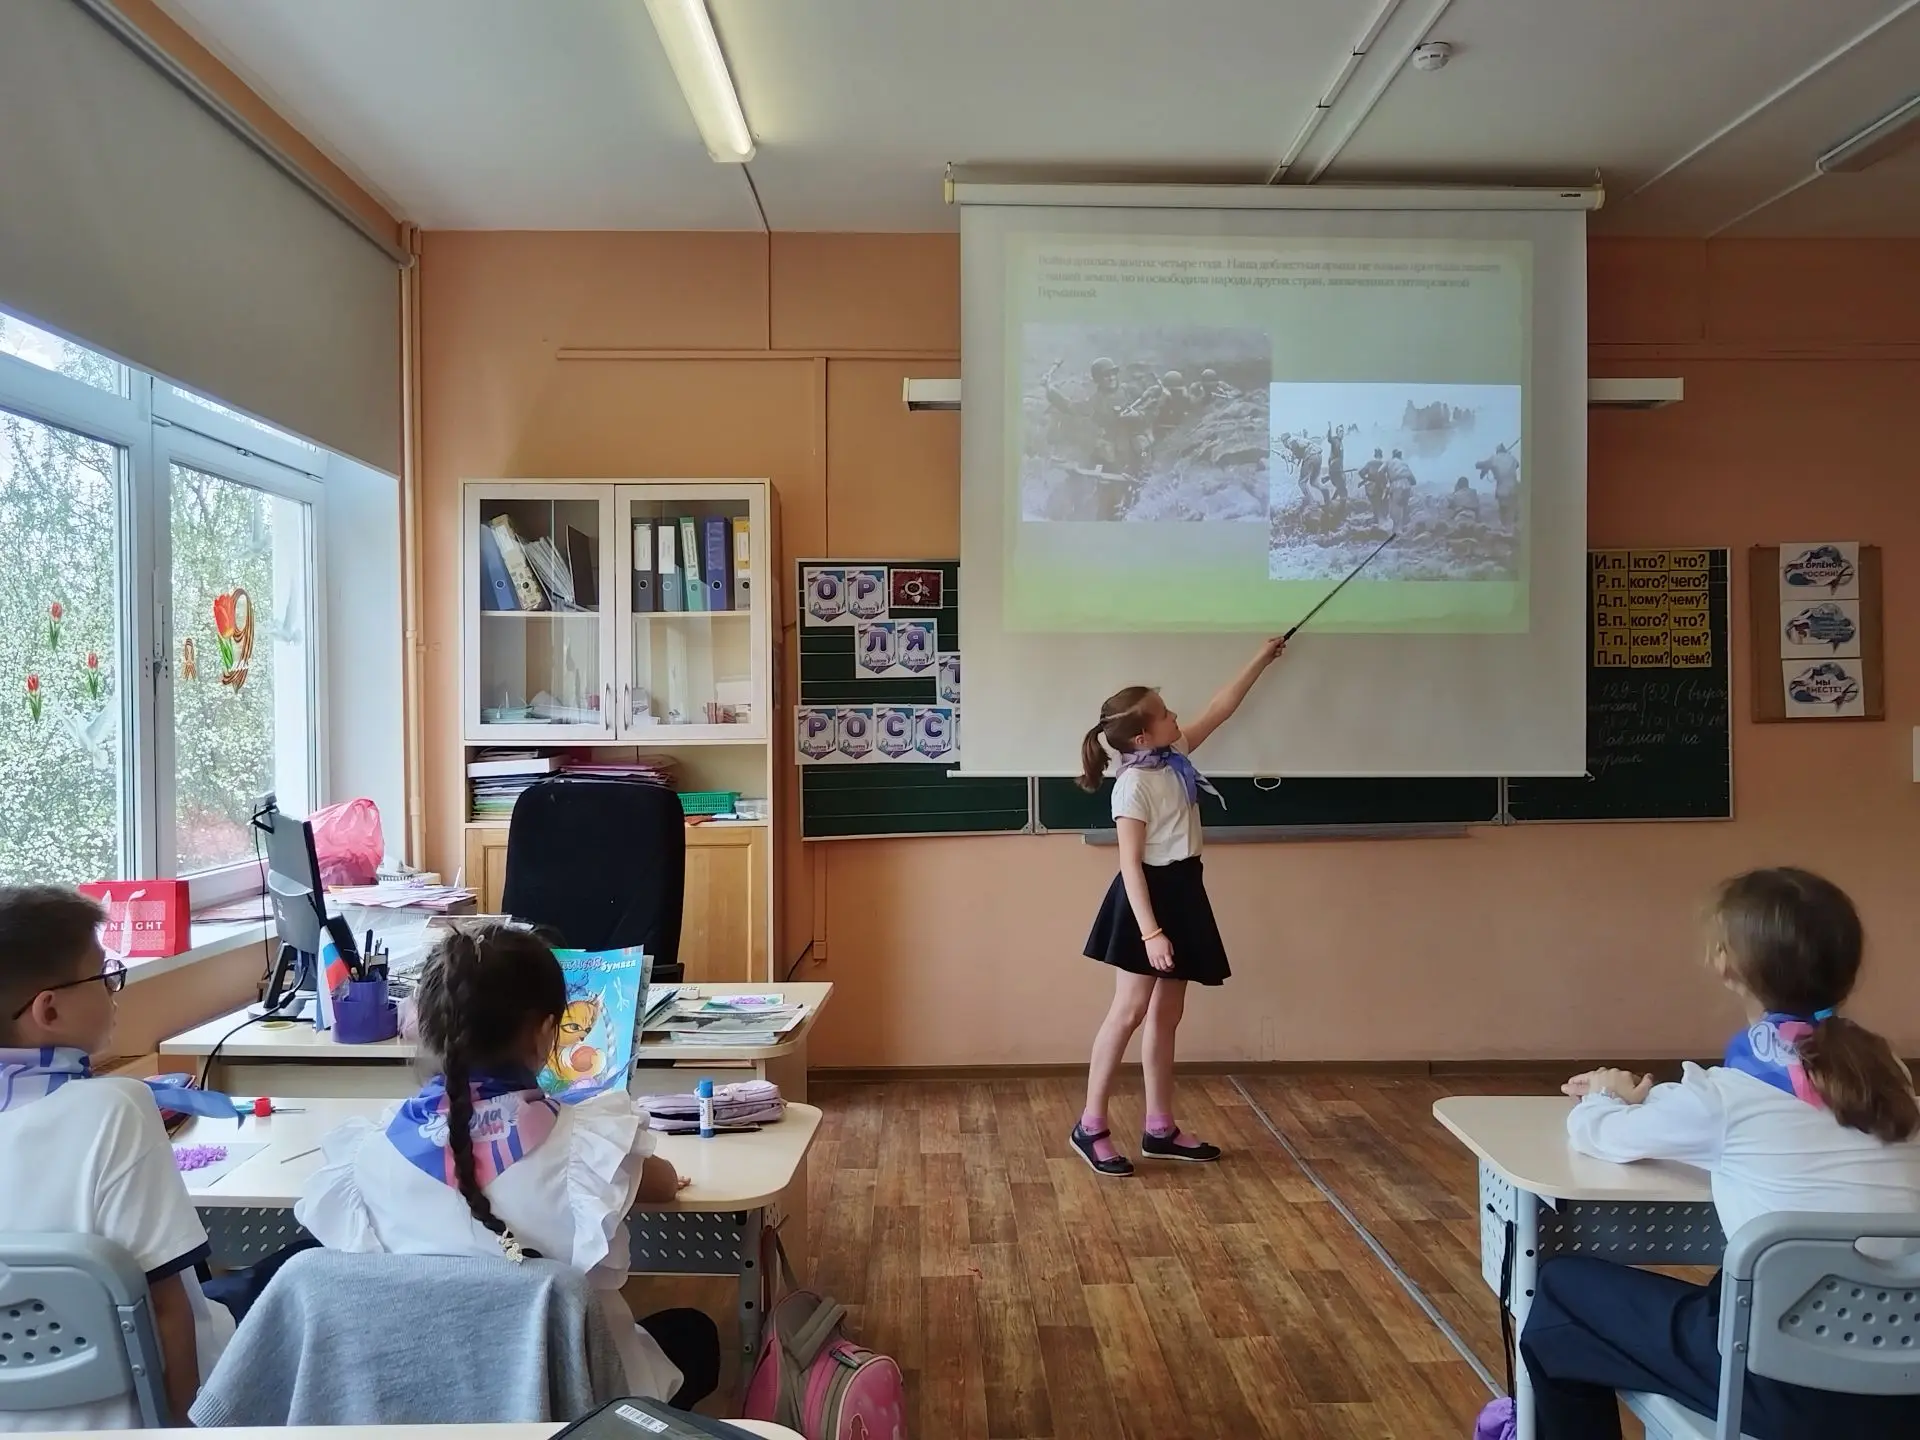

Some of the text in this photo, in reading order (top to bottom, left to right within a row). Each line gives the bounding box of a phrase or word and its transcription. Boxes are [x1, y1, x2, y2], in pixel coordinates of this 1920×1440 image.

[1227, 257, 1257, 270] Наша
[1121, 273, 1136, 282] но
[1146, 272, 1208, 285] освободила
[1211, 276, 1252, 287] народы
[1253, 277, 1291, 288] других
[1595, 553, 1706, 569] И.п. кто? что?
[1597, 573, 1708, 589] Р.п. кого? чего?
[1597, 592, 1708, 608] Д.п. кому? чему?
[1597, 613, 1706, 627] В.п. кого? что?
[1633, 632, 1669, 646] кем?
[1673, 632, 1709, 646] чем?
[1597, 650, 1627, 665] П.п.
